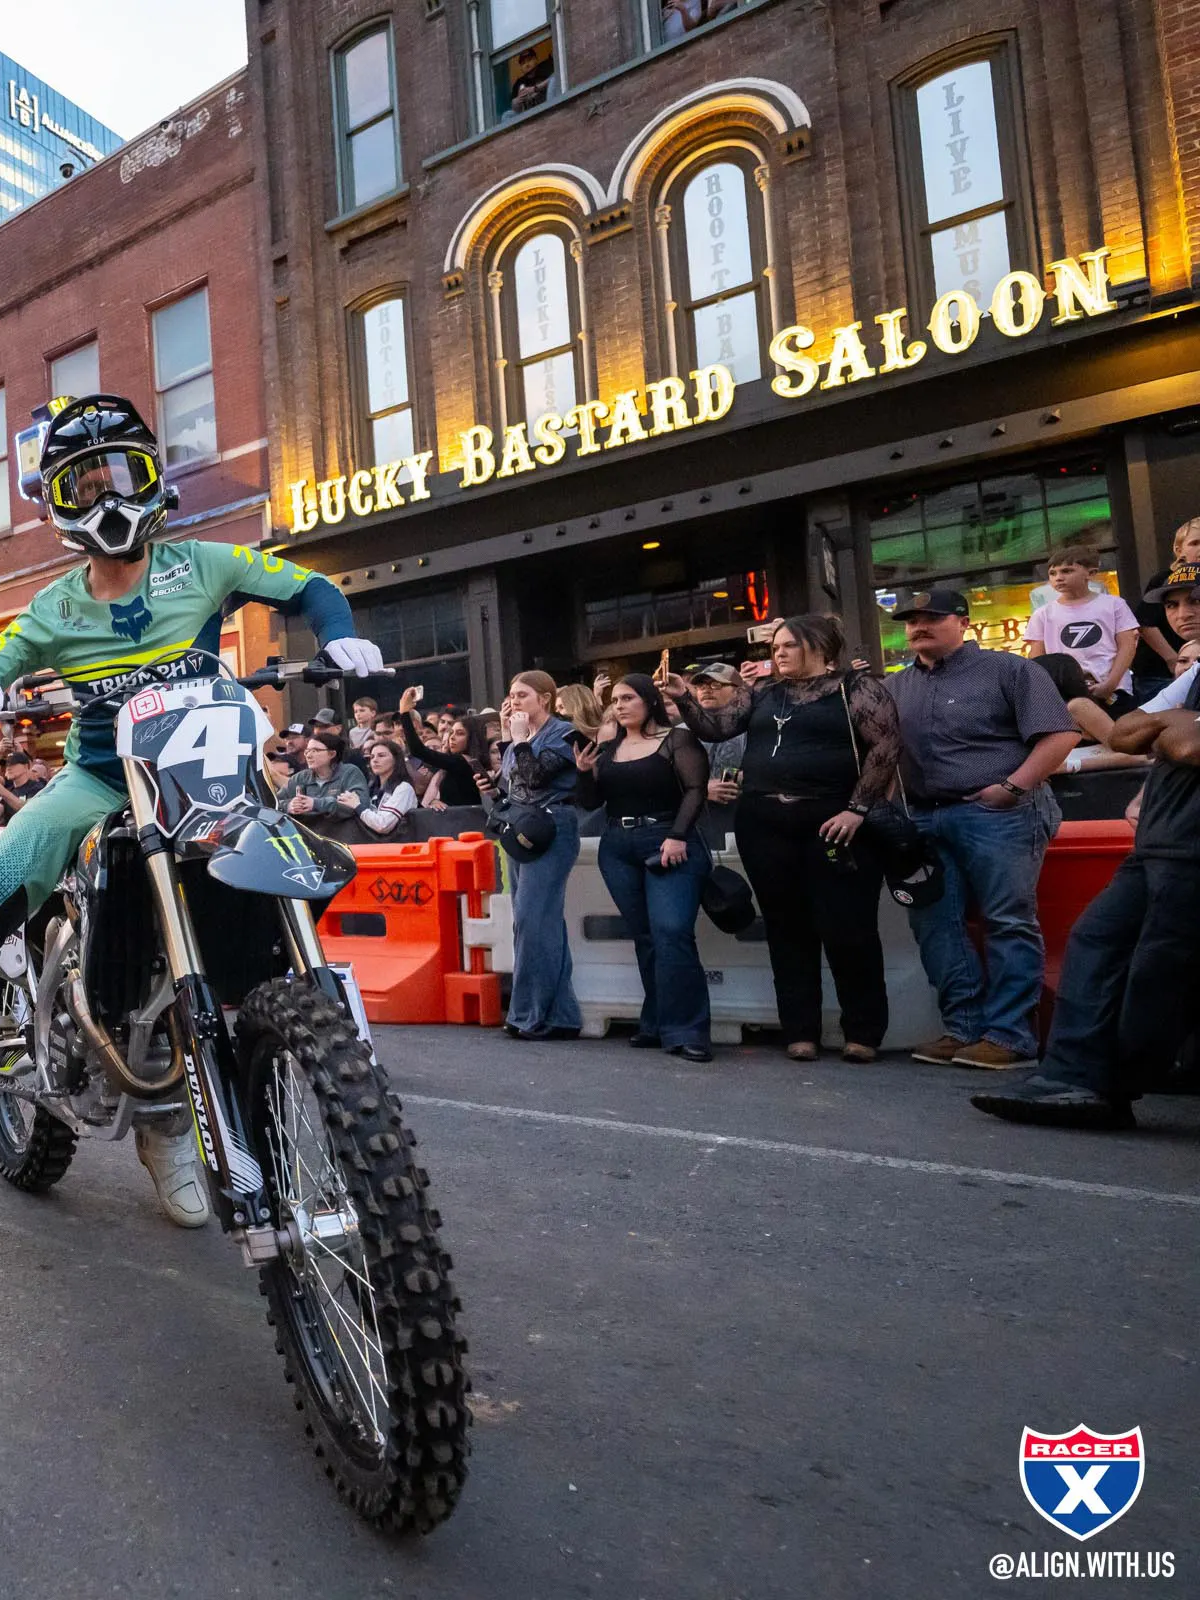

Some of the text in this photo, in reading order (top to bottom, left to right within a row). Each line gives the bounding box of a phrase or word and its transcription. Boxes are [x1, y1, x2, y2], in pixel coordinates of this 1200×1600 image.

[942, 82, 972, 197] LIVE
[532, 248, 551, 342] LUCKY
[288, 246, 1119, 535] LUCKY BASTARD SALOON
[87, 435, 106, 446] FOX
[151, 562, 191, 584] COMETIC
[1068, 624, 1095, 648] 7
[87, 659, 188, 696] TRIUMPH
[157, 705, 253, 780] 4
[183, 1052, 220, 1172] DUNLOP
